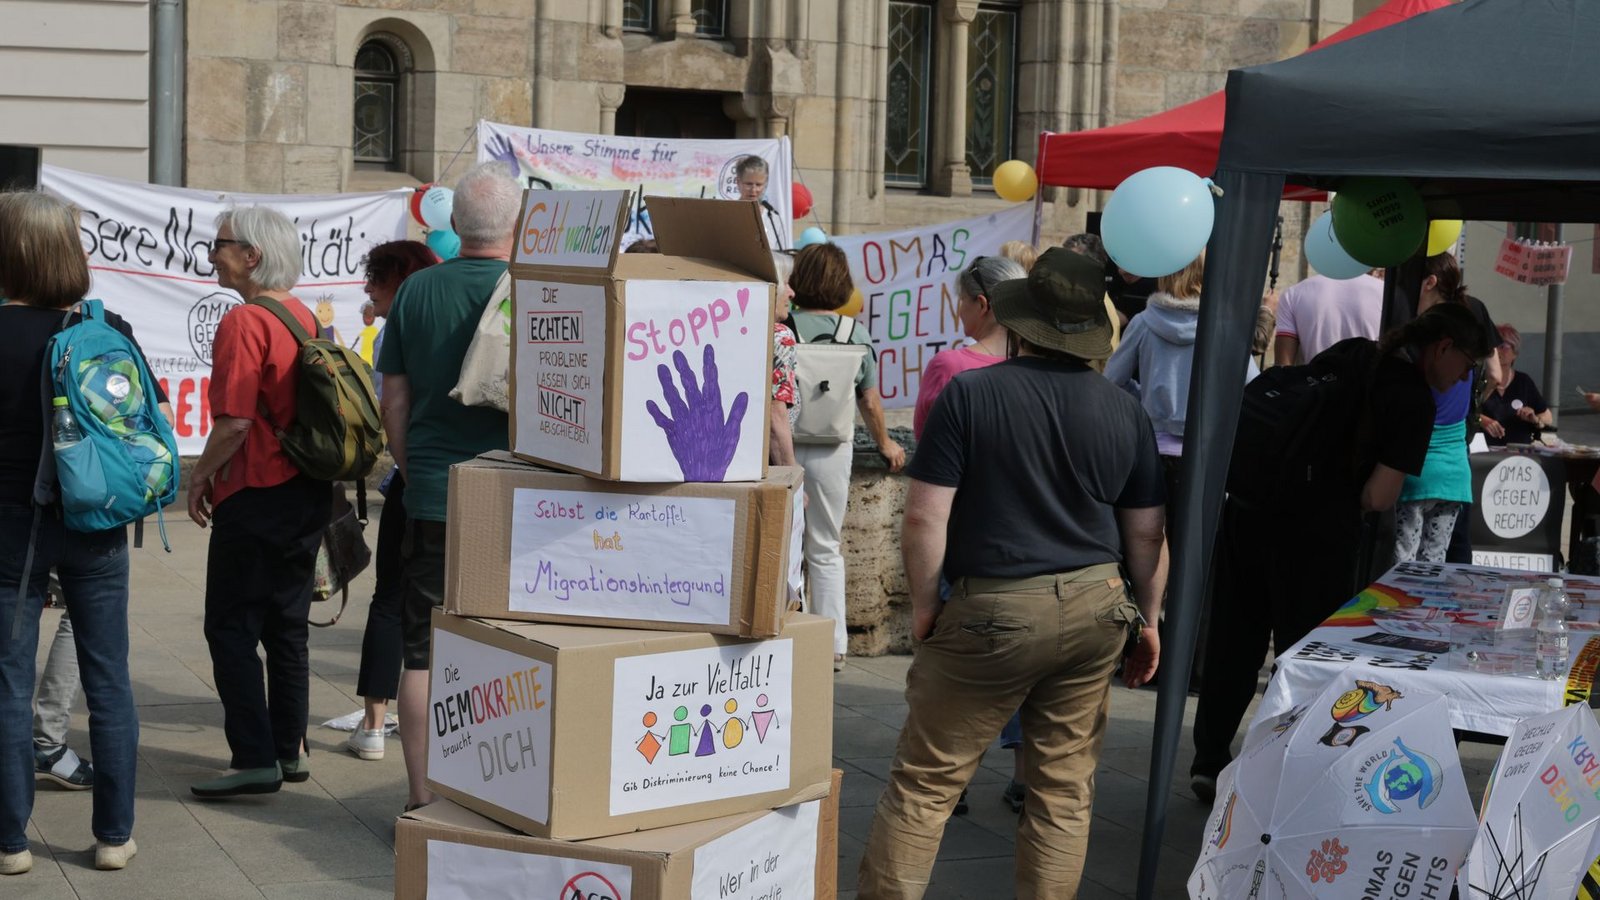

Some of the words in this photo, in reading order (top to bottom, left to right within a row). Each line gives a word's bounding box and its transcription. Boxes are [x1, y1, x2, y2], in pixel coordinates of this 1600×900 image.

[527, 134, 574, 156] Unsere
[582, 139, 641, 160] Stimme
[80, 209, 158, 267] sere
[522, 200, 571, 255] Geht
[863, 228, 970, 284] OMAS
[542, 287, 559, 303] DIE
[862, 282, 962, 344] EGEN
[530, 316, 580, 341] ECHTEN
[627, 287, 751, 361] Stopp!
[537, 372, 567, 389] LASSEN
[572, 375, 590, 391] SICH
[540, 389, 582, 424] NICHT
[540, 420, 590, 444] ABSCHIEBEN
[1499, 465, 1532, 482] OMAS
[535, 500, 585, 520] Selbst
[595, 504, 618, 521] die
[629, 502, 687, 527] Kartoffel
[1493, 489, 1540, 506] GEGEN
[593, 528, 624, 551] hat
[1494, 513, 1537, 530] RECHTS
[525, 560, 725, 606] Migrationshintergrund
[444, 663, 461, 684] Die
[645, 675, 665, 701] Ja
[671, 681, 699, 698] zur
[707, 654, 774, 696] Vielfalt!
[433, 665, 546, 738] DEMOKRATIE
[442, 731, 472, 759] braucht
[477, 727, 537, 783] DICH
[1353, 776, 1363, 793] THE
[1359, 750, 1388, 773] WORLD
[622, 781, 638, 793] Gib
[642, 770, 712, 789] Diskriminierung
[719, 765, 738, 779] keine
[719, 872, 744, 900] Wer
[750, 859, 759, 883] in
[764, 851, 780, 873] der
[1390, 851, 1421, 900] GEN
[1419, 856, 1448, 900] HTS
